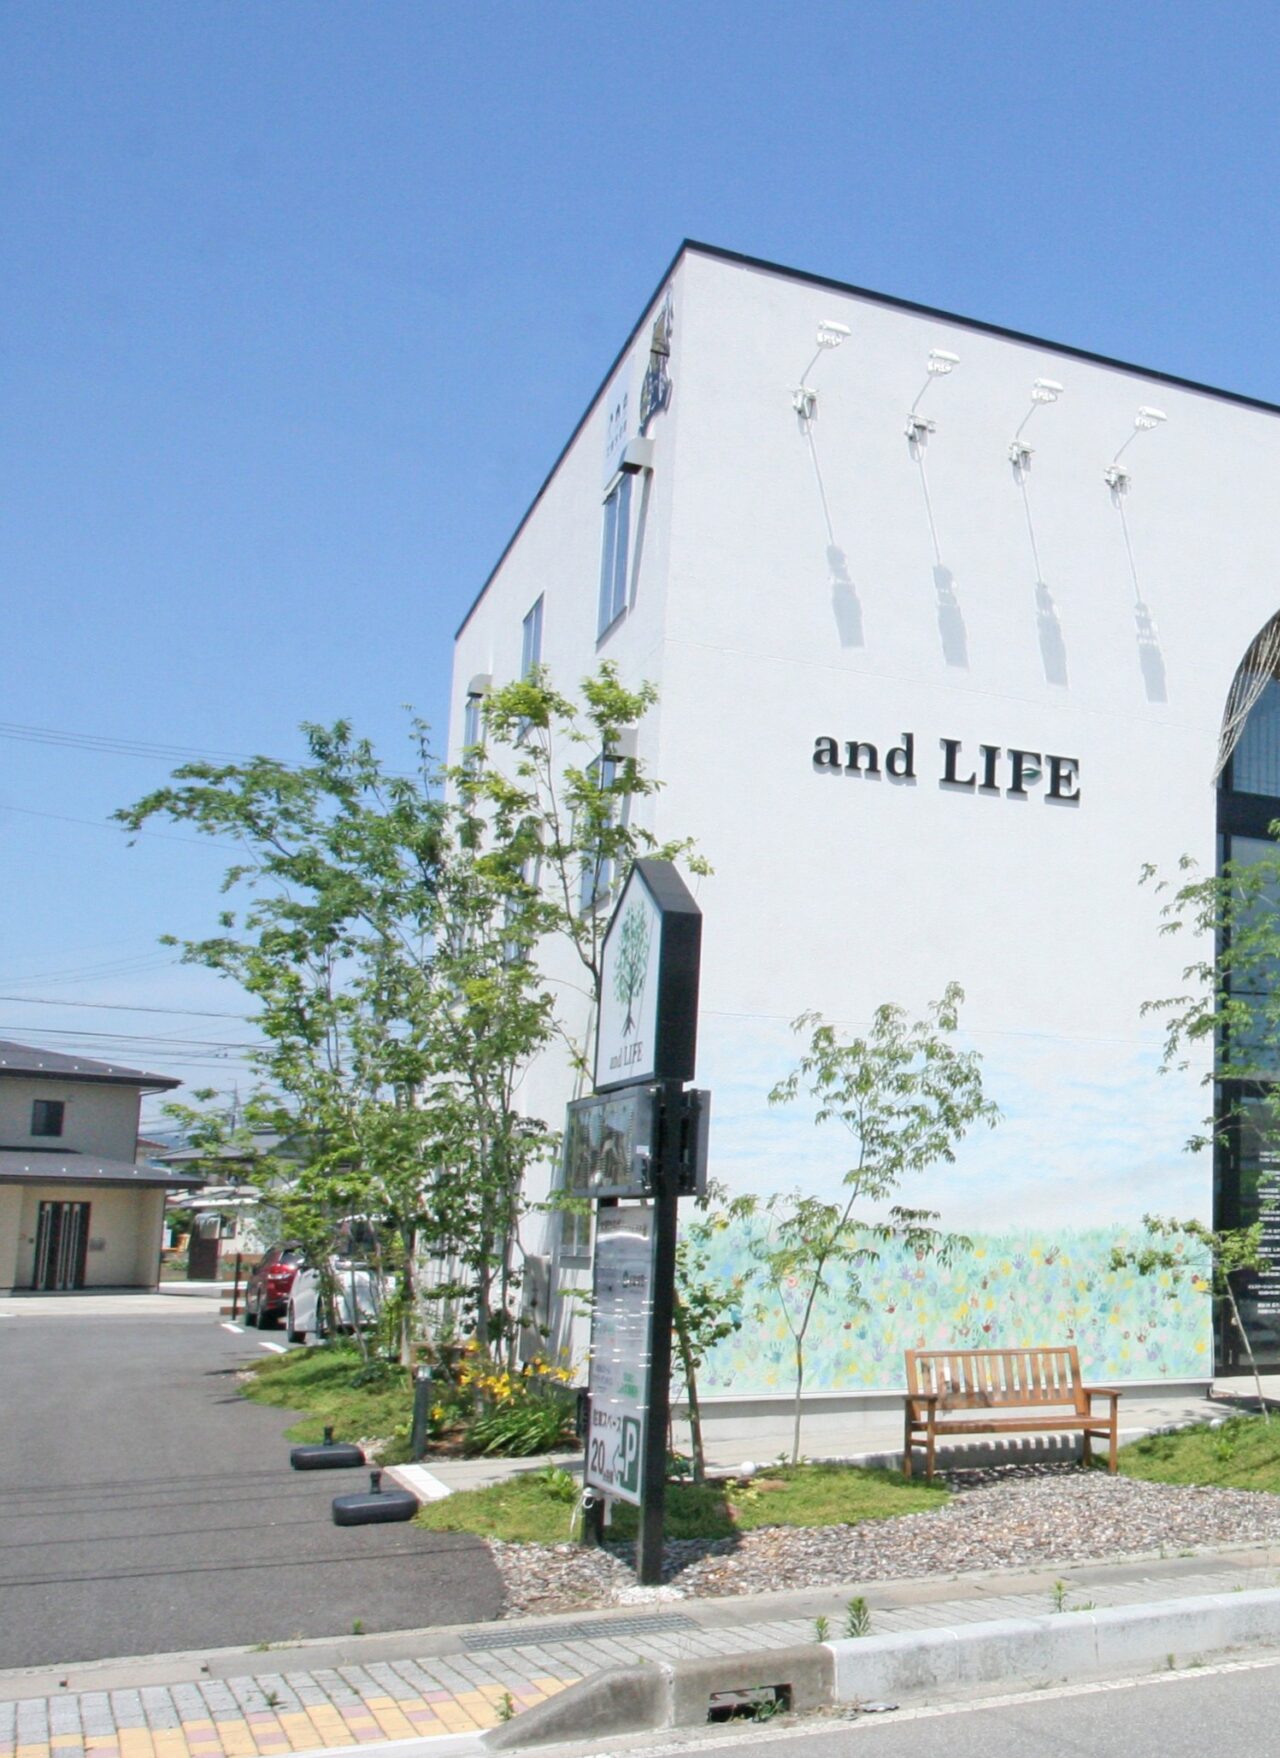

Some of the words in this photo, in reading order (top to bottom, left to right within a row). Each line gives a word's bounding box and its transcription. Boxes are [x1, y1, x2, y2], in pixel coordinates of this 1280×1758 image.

[812, 732, 916, 779] and
[939, 738, 1080, 801] LIFE
[610, 1047, 622, 1070] and
[624, 1041, 643, 1066] LIFE
[591, 1437, 605, 1475] 20
[624, 1421, 637, 1482] P
